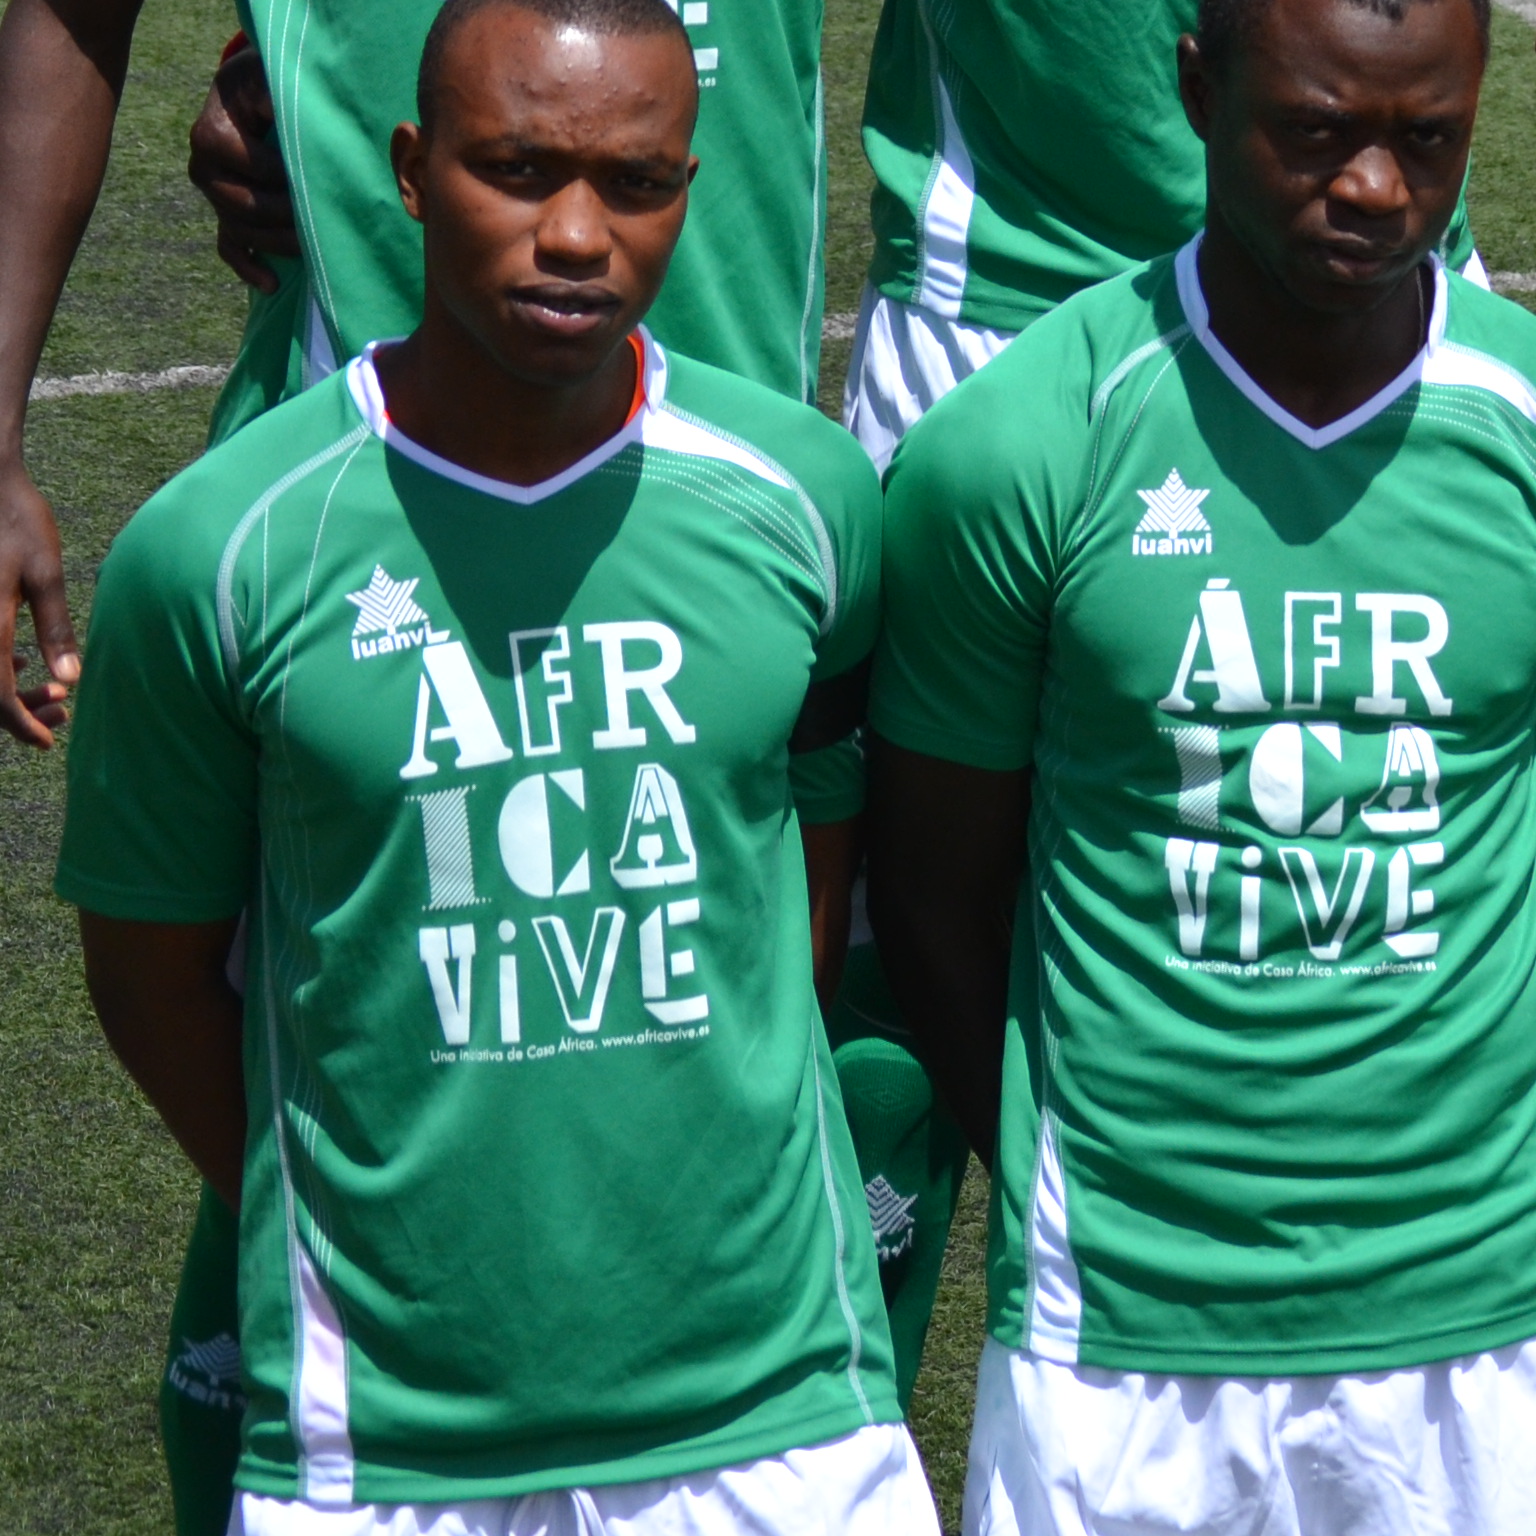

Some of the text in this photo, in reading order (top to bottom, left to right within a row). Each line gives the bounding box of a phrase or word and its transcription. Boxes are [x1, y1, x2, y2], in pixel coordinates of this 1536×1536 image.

[1132, 533, 1213, 556] luanvi
[351, 622, 432, 660] luanvi
[400, 621, 696, 779] ÁFR
[1157, 578, 1453, 717] ÁFR
[404, 763, 698, 912] ICA
[1157, 721, 1441, 838] ICA
[1164, 836, 1444, 962] ViVE
[419, 898, 709, 1045] ViVE
[1165, 955, 1189, 971] Una
[1192, 960, 1241, 976] iniciativa
[1244, 962, 1260, 977] de
[1263, 963, 1294, 977] Casa
[430, 1050, 456, 1064] Una
[507, 1046, 523, 1061] de
[527, 1044, 556, 1060] Casa
[558, 1037, 598, 1055] África.
[602, 1025, 710, 1048] www.africavive.es
